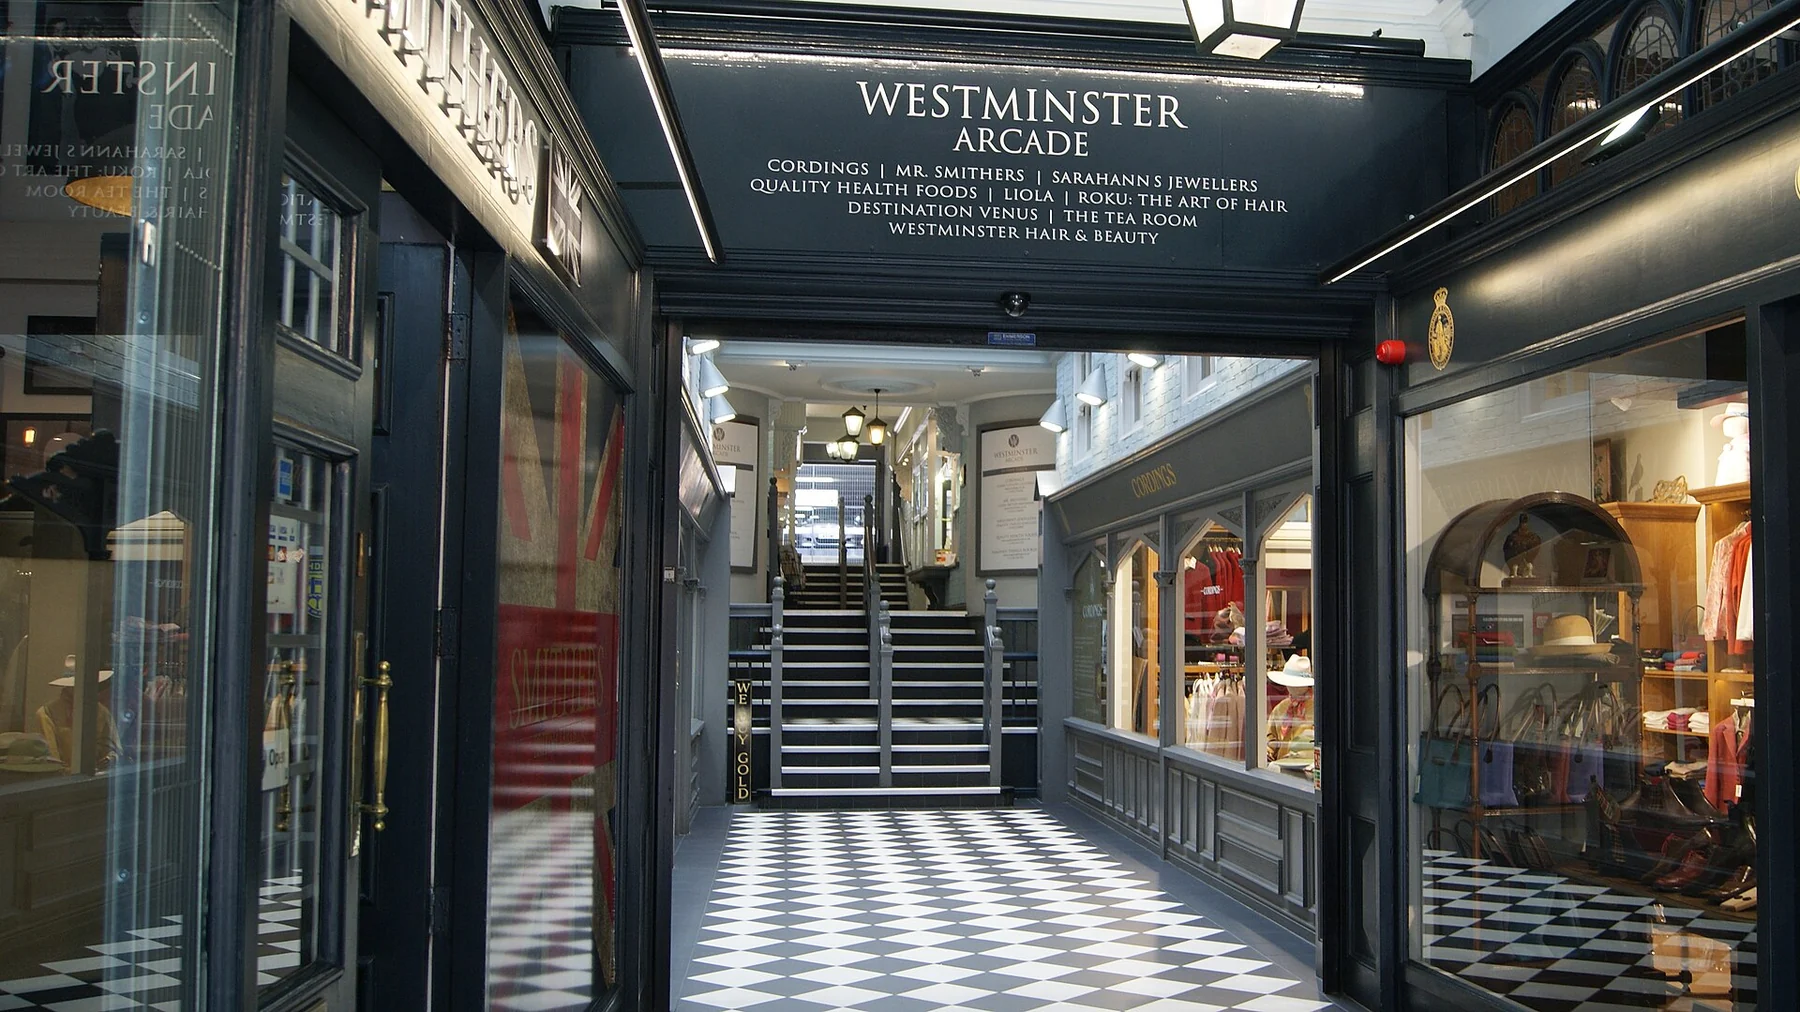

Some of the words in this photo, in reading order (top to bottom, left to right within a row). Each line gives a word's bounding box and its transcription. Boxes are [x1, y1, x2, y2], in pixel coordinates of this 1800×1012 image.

[855, 80, 1189, 129] WESTMINSTER
[952, 126, 1090, 157] ARCADE
[767, 158, 869, 176] CORDINGS
[895, 164, 929, 178] MR.
[934, 165, 1025, 182] SMITHERS
[1167, 175, 1258, 193] JEWELLERS
[750, 178, 832, 195] QUALITY
[837, 181, 908, 197] HEALTH
[916, 184, 978, 200] FOODS
[1004, 187, 1055, 203] LIOLA
[1078, 190, 1133, 206] ROKU:
[1137, 193, 1173, 208] THE
[1177, 195, 1211, 209] ART
[1215, 197, 1238, 211] OF
[1244, 198, 1289, 213] HAIR
[848, 201, 973, 218] DESTINATION
[978, 206, 1038, 221] VENUS
[1063, 209, 1099, 224] THE
[1104, 211, 1137, 225] TEA
[1142, 212, 1198, 228] ROOM
[888, 221, 1021, 239] WESTMINSTER
[1025, 227, 1071, 241] HAIR
[1074, 229, 1089, 242] &
[1094, 229, 1159, 245] BEAUTY
[1131, 463, 1176, 498] CORDINGS
[509, 645, 604, 730] SMITHERS
[737, 752, 750, 800] GOLD
